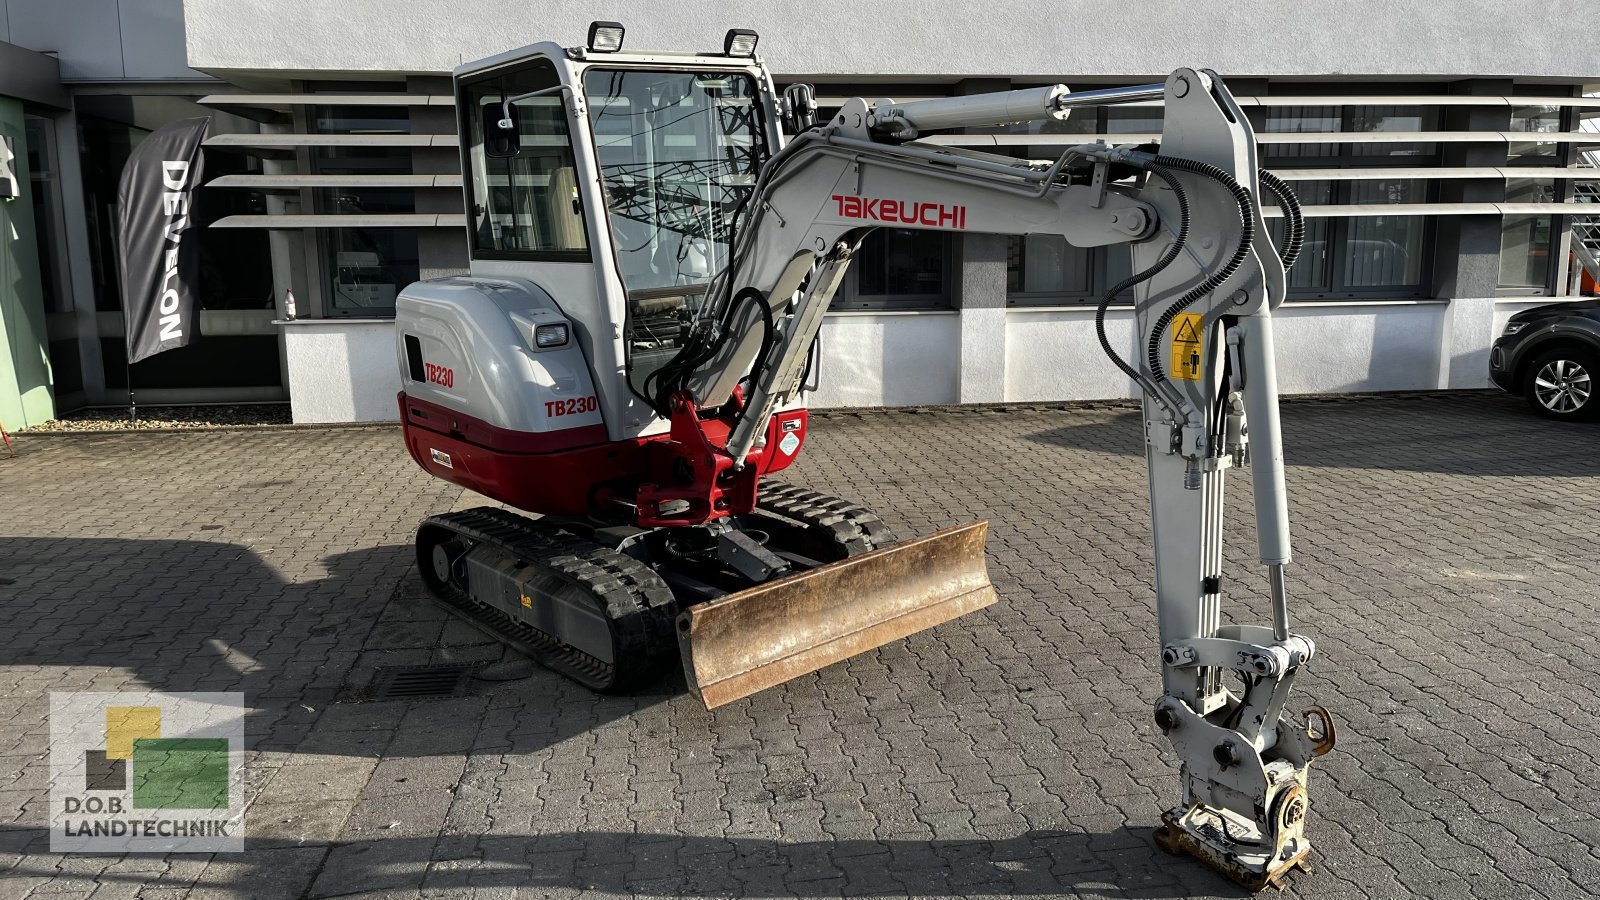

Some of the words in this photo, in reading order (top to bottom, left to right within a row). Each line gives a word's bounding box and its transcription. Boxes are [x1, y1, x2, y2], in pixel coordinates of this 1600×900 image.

[159, 160, 189, 342] DEVELON
[425, 363, 454, 388] TB230
[544, 396, 597, 417] TB230
